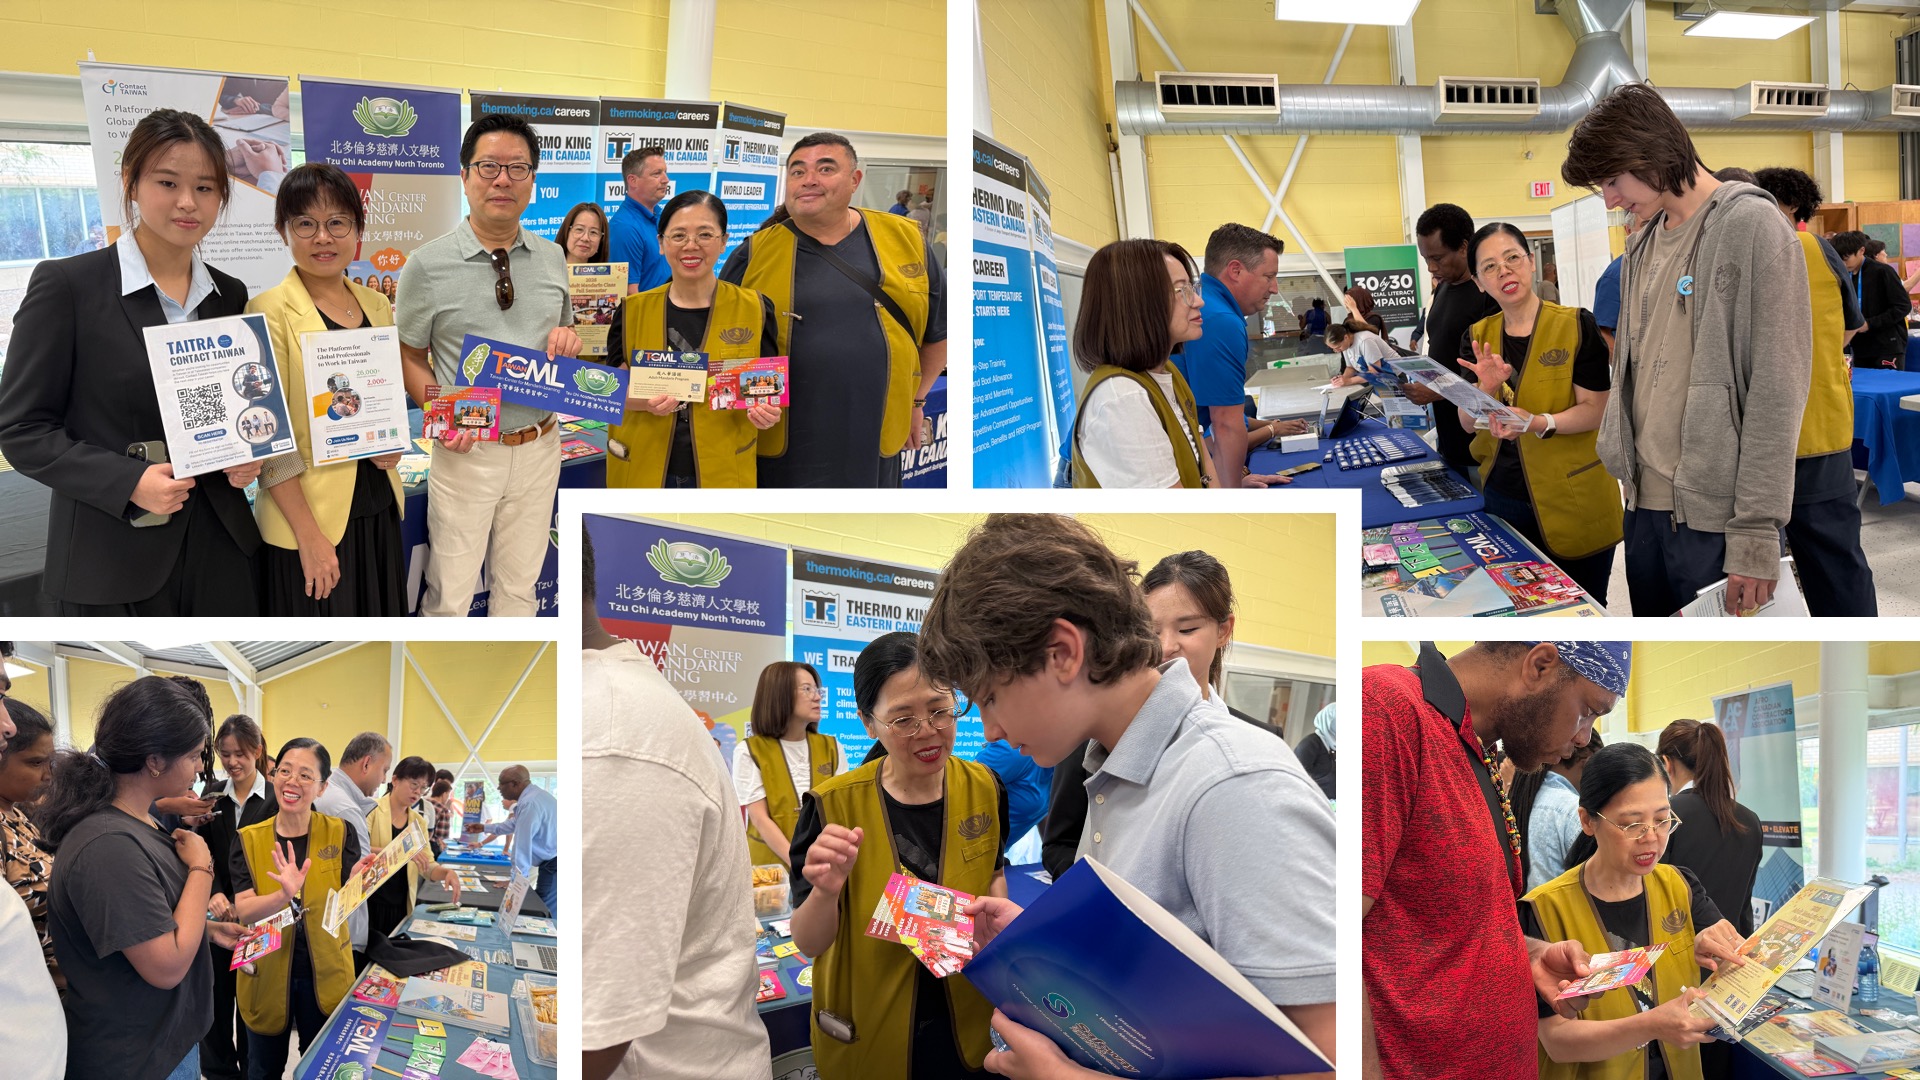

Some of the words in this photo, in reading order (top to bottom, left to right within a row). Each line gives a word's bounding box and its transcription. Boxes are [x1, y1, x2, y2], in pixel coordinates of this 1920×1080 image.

[114, 104, 152, 114] Platform
[481, 102, 590, 118] thermoking.ca/careers
[610, 108, 710, 121] thermoking.ca/careers
[106, 118, 136, 126] Global
[729, 112, 781, 130] thermoking.ca/careers
[330, 140, 440, 158] 北多倫多慈濟人文學校
[566, 136, 592, 150] KING
[685, 138, 709, 151] KING
[743, 141, 766, 154] THERMO
[767, 144, 779, 156] KING
[556, 151, 591, 161] CANADA
[676, 152, 708, 162] CANADA
[742, 154, 761, 164] EASTERN
[762, 155, 777, 166] CANADA
[358, 158, 393, 168] Academy
[540, 187, 559, 198] YOU
[723, 184, 743, 196] WORLD
[744, 186, 763, 197] LEADER
[1535, 182, 1551, 196] EXIT
[388, 192, 426, 202] CENTER
[1006, 201, 1024, 220] KING
[538, 217, 548, 225] the
[1001, 216, 1026, 235] CANADA
[378, 254, 400, 266] 你好
[973, 259, 1005, 278] CAREER
[1354, 276, 1379, 291] 30
[1389, 274, 1413, 290] 30
[988, 290, 1022, 302] TEMPERATURE
[976, 306, 995, 317] STARTS
[997, 306, 1011, 316] HERE
[166, 336, 216, 355] TAITRA
[170, 350, 210, 366] CONTACT
[212, 347, 246, 360] TAIWAN
[336, 350, 371, 359] Professionals
[645, 352, 677, 363] TCML
[492, 350, 565, 389] TCML
[989, 359, 1006, 368] Training
[992, 373, 1012, 383] Allowance
[524, 382, 543, 390] Mandarin
[580, 394, 597, 402] Academy
[985, 392, 993, 400] and
[993, 387, 1014, 398] Mentoring
[980, 402, 1008, 418] Advancement
[1009, 396, 1033, 410] Opportunities
[993, 414, 1021, 429] Compensation
[991, 434, 1008, 447] Benefits
[1026, 420, 1042, 431] Program
[806, 560, 935, 590] thermoking.ca/careers
[537, 581, 553, 591] Tzu
[468, 599, 487, 612] Lea
[616, 584, 760, 615] 北多倫多慈濟人文學校
[608, 602, 629, 612] Tzu
[631, 604, 649, 615] Chi
[651, 606, 699, 622] Academy
[701, 612, 728, 623] North
[730, 616, 766, 627] Toronto
[846, 600, 901, 619] THERMO
[906, 607, 929, 622] KIN
[846, 615, 893, 631] EASTERN
[692, 647, 743, 662] CENTER
[804, 652, 824, 666] WE
[832, 654, 856, 667] TRA
[650, 655, 738, 673] ANDARIN
[836, 687, 852, 697] TKU
[1755, 696, 1768, 704] AFRO
[1752, 708, 1793, 720] CONTRACTORS
[1753, 702, 1781, 713] CANADIAN
[836, 711, 844, 719] in
[846, 711, 857, 719] the
[1751, 719, 1786, 728] ASSOCIATION
